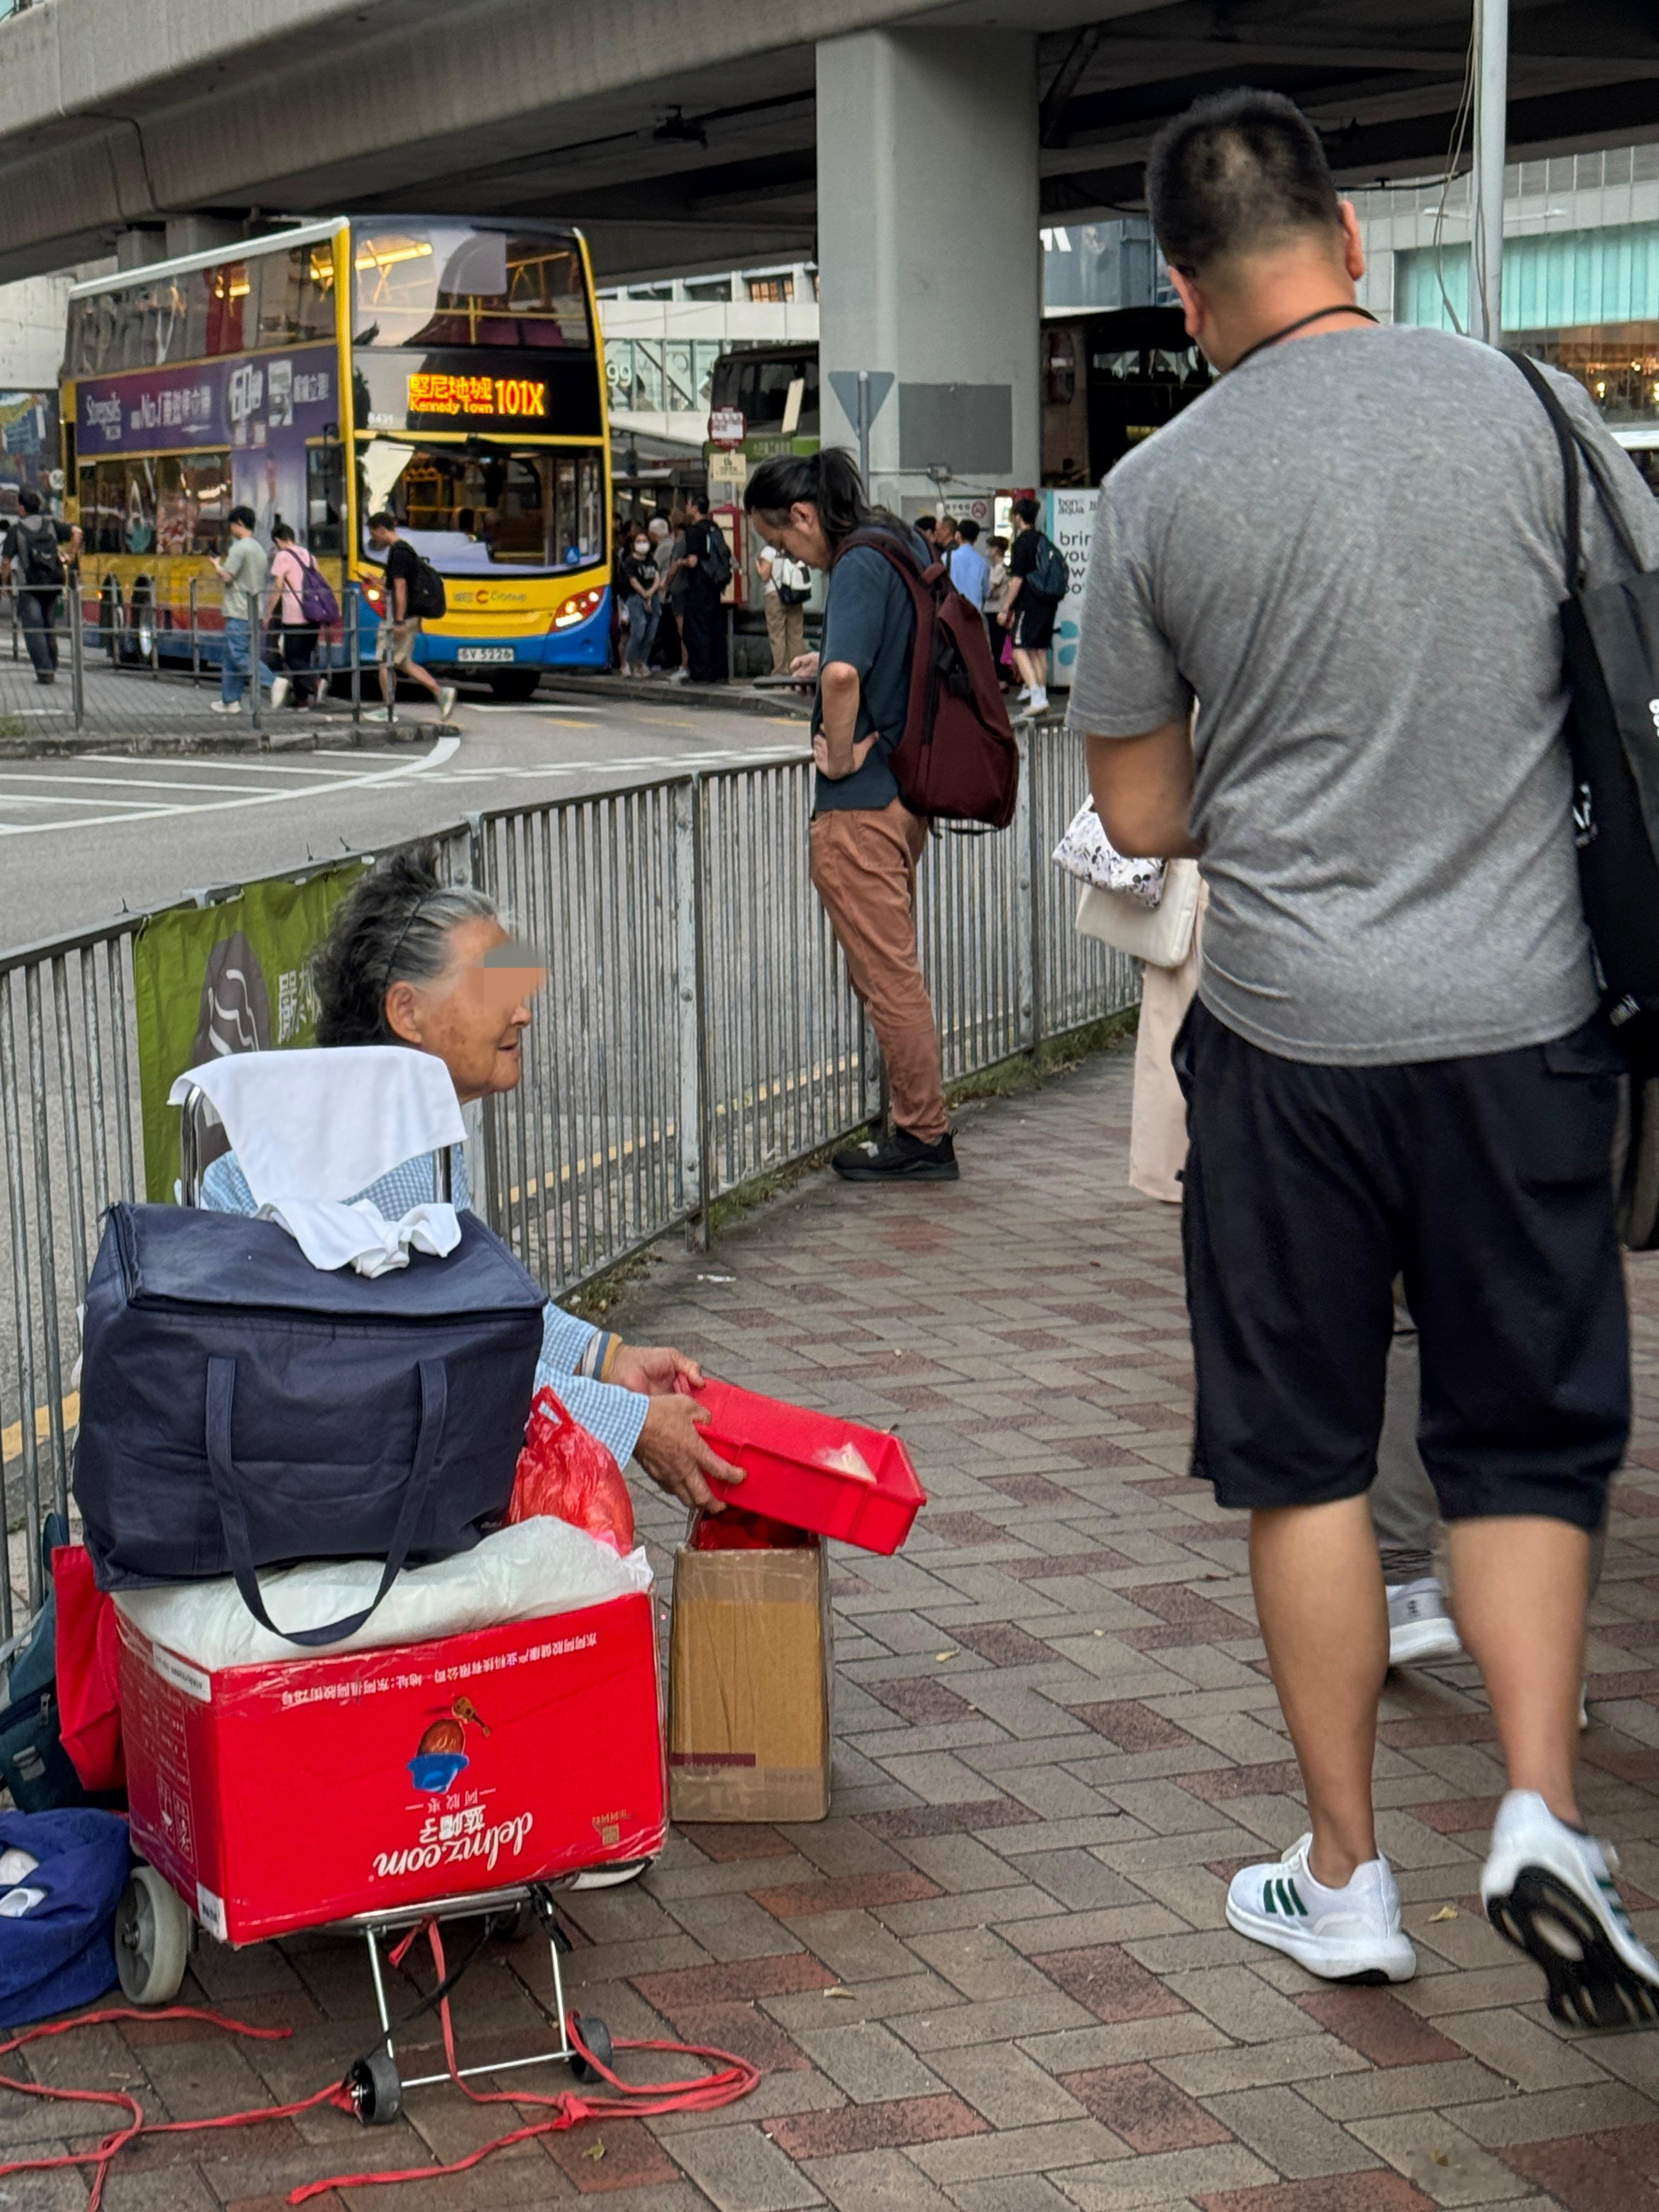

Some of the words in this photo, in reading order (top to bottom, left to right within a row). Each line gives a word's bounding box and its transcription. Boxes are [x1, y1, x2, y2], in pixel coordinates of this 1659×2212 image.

[409, 375, 492, 400] 堅尼地城
[409, 397, 460, 415] Kennedy
[462, 397, 493, 414] Town
[494, 379, 545, 416] 101X
[419, 1804, 487, 1844] 蓝帽子
[372, 1812, 534, 1877] delmz.com
